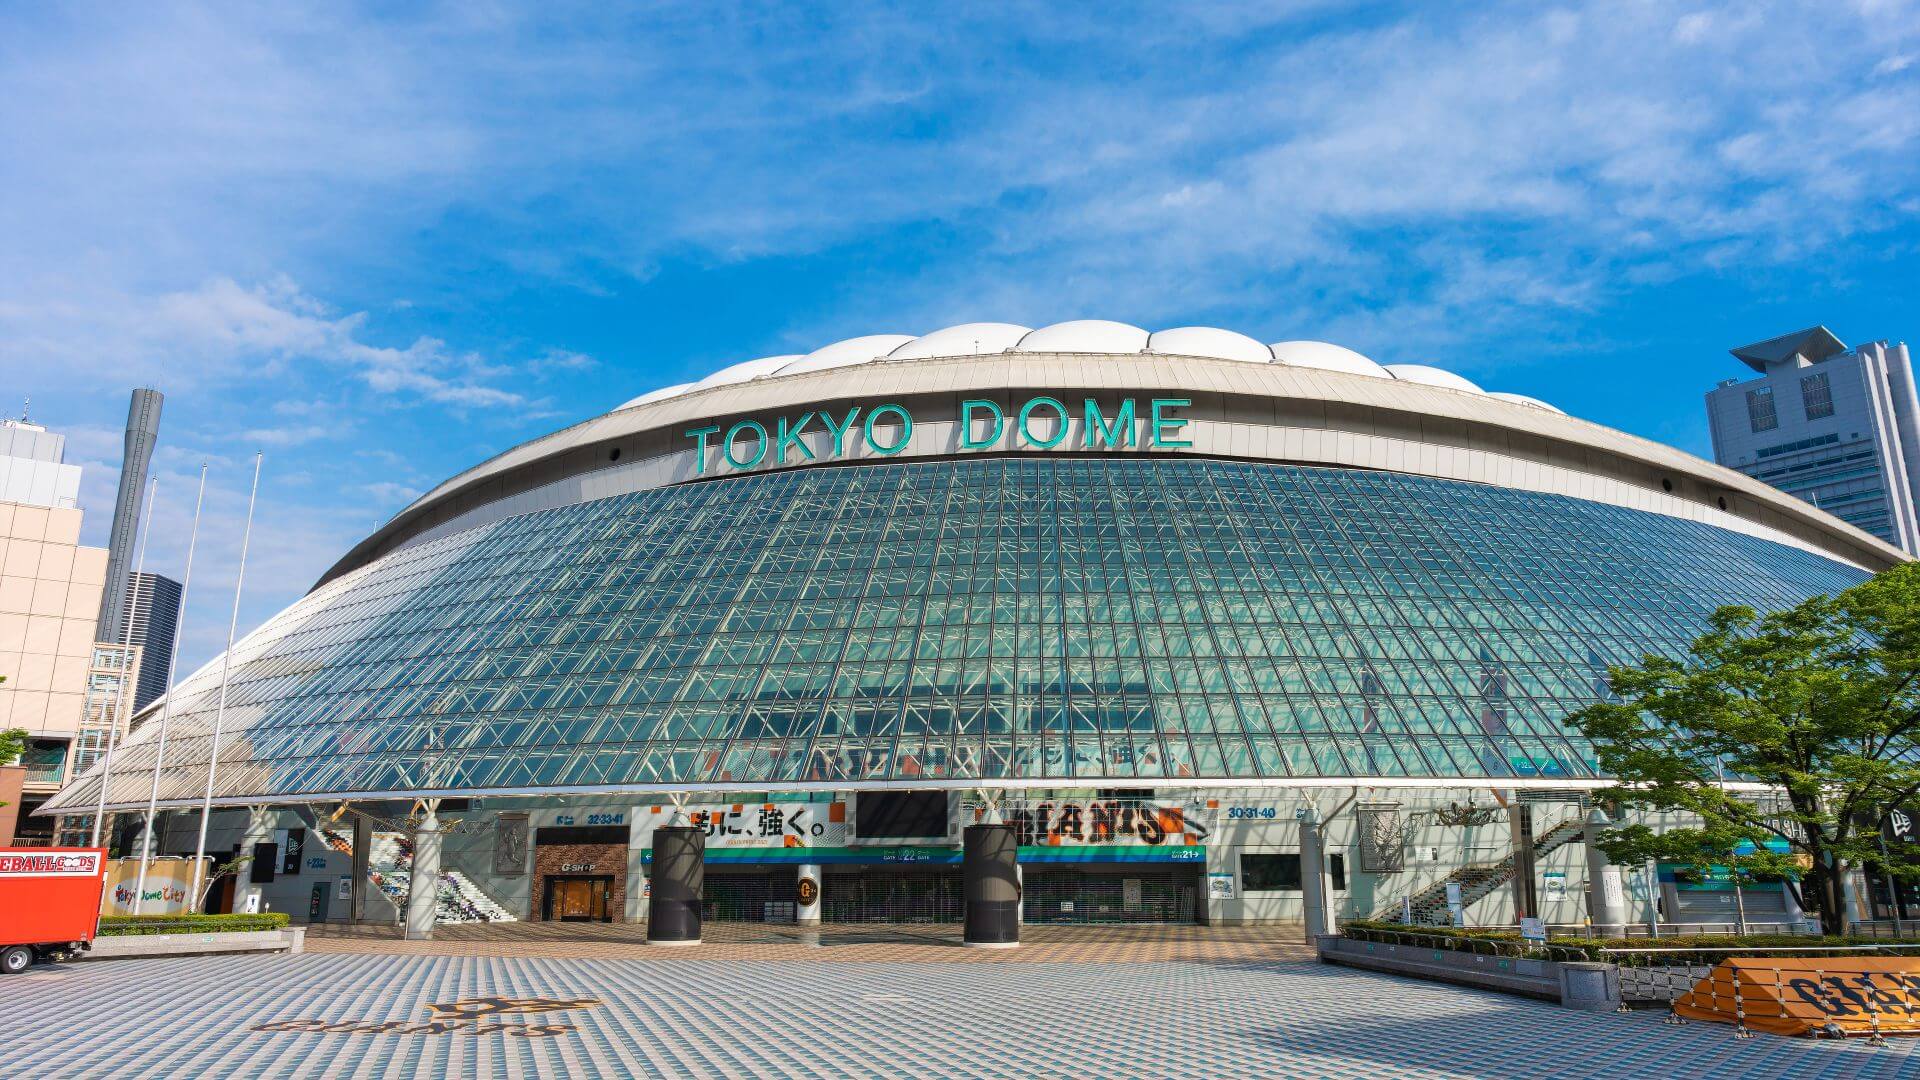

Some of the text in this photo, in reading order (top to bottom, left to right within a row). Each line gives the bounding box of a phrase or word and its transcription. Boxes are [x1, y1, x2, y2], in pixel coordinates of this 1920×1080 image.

[685, 397, 1193, 474] TOKYO DOME
[1182, 850, 1192, 859] 21
